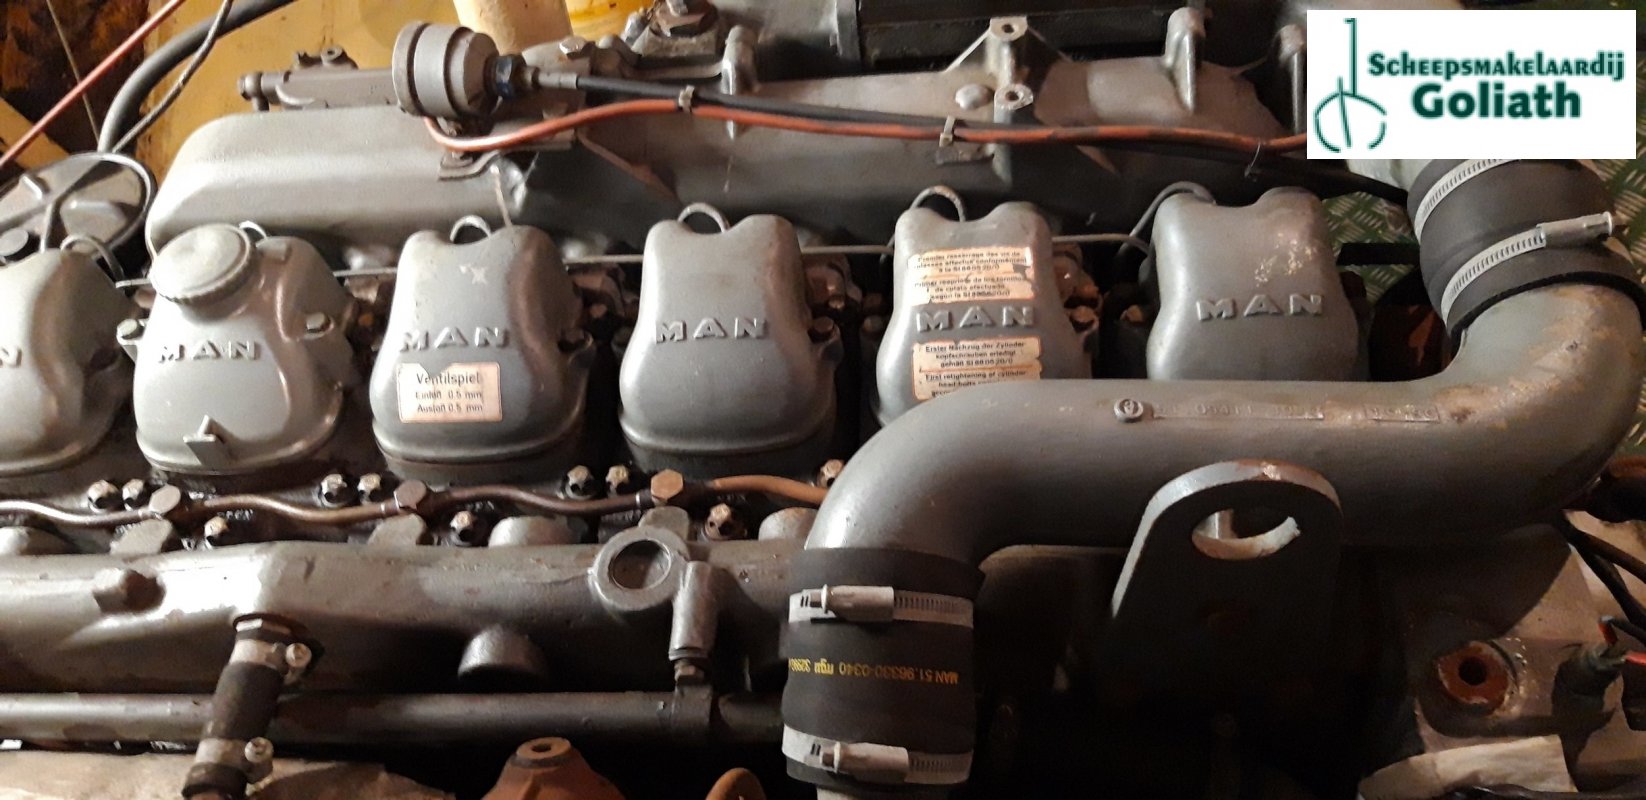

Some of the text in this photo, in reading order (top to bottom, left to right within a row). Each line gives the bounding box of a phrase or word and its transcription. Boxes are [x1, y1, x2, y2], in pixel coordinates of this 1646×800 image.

[1196, 293, 1323, 320] MAN
[655, 316, 769, 343] MAN
[916, 306, 1034, 333] MAN
[400, 325, 510, 352] MAN
[995, 341, 1024, 350] Zylinder
[158, 339, 262, 363] MAN
[417, 371, 480, 387] Ventilspiel
[465, 391, 482, 399] mm
[466, 404, 482, 412] mm
[935, 670, 958, 685] MAN
